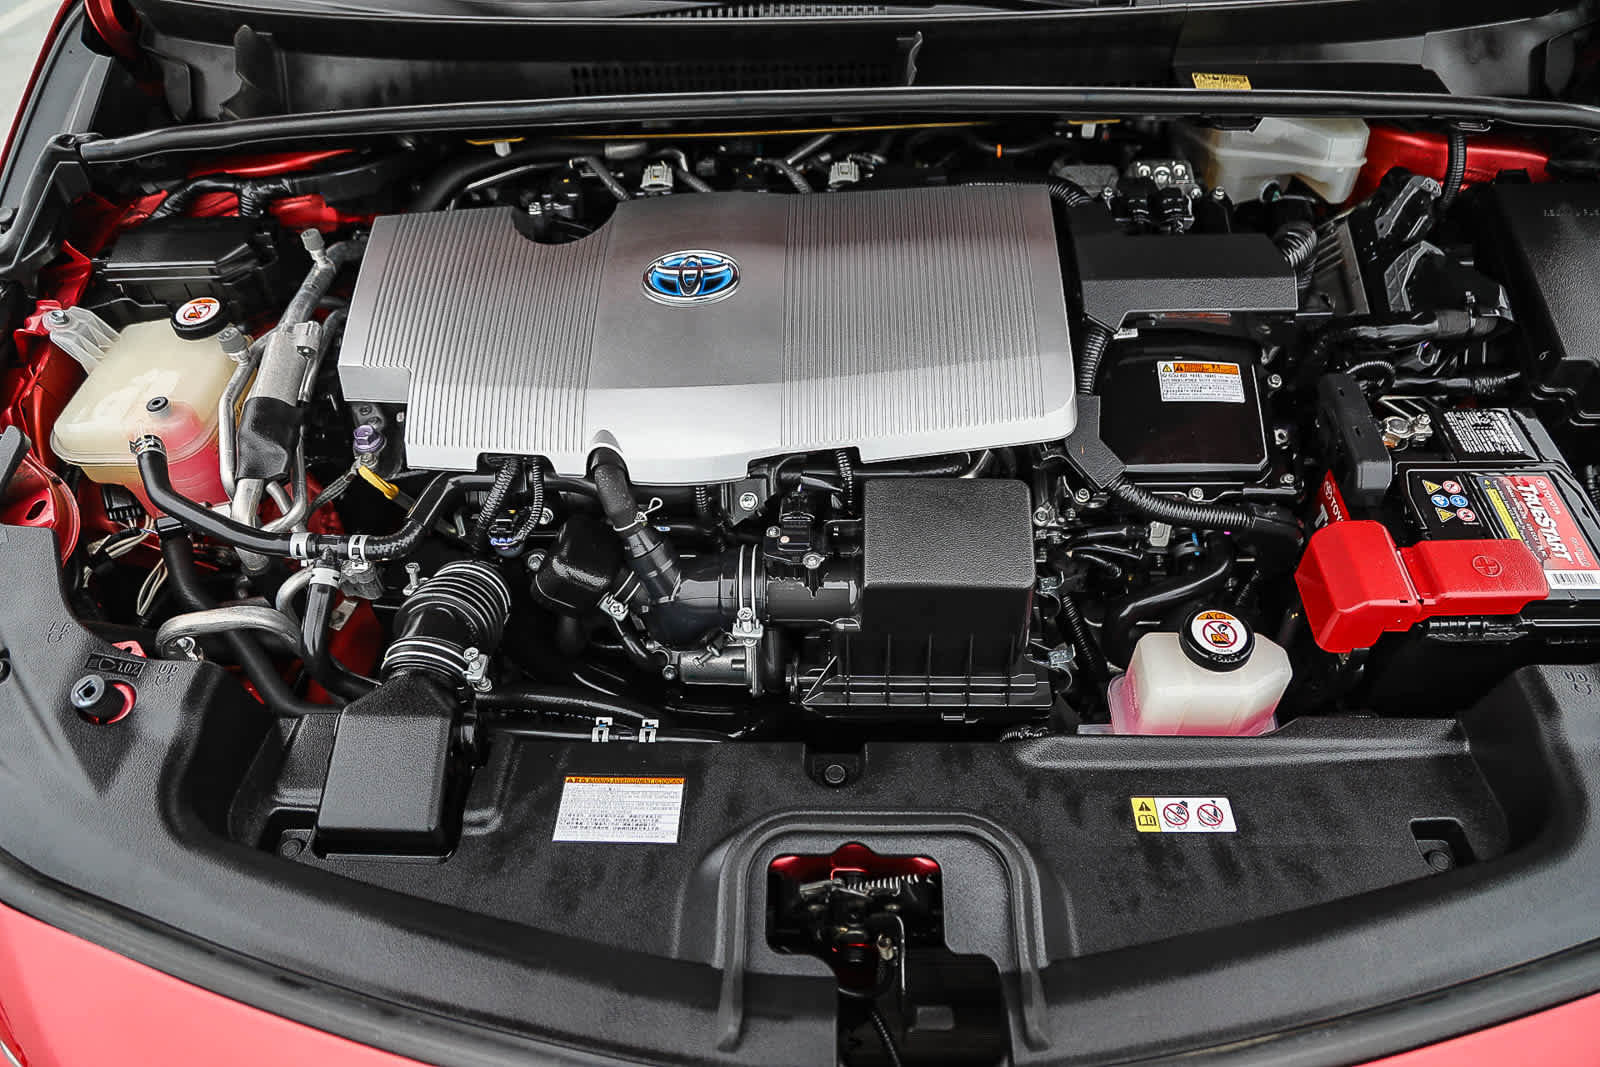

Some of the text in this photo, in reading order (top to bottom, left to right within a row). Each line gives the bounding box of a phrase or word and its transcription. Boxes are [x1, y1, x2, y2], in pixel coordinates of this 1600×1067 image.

[1331, 496, 1344, 522] TOY
[1543, 488, 1561, 515] TOYOTA
[1517, 483, 1573, 562] TRUESTART
